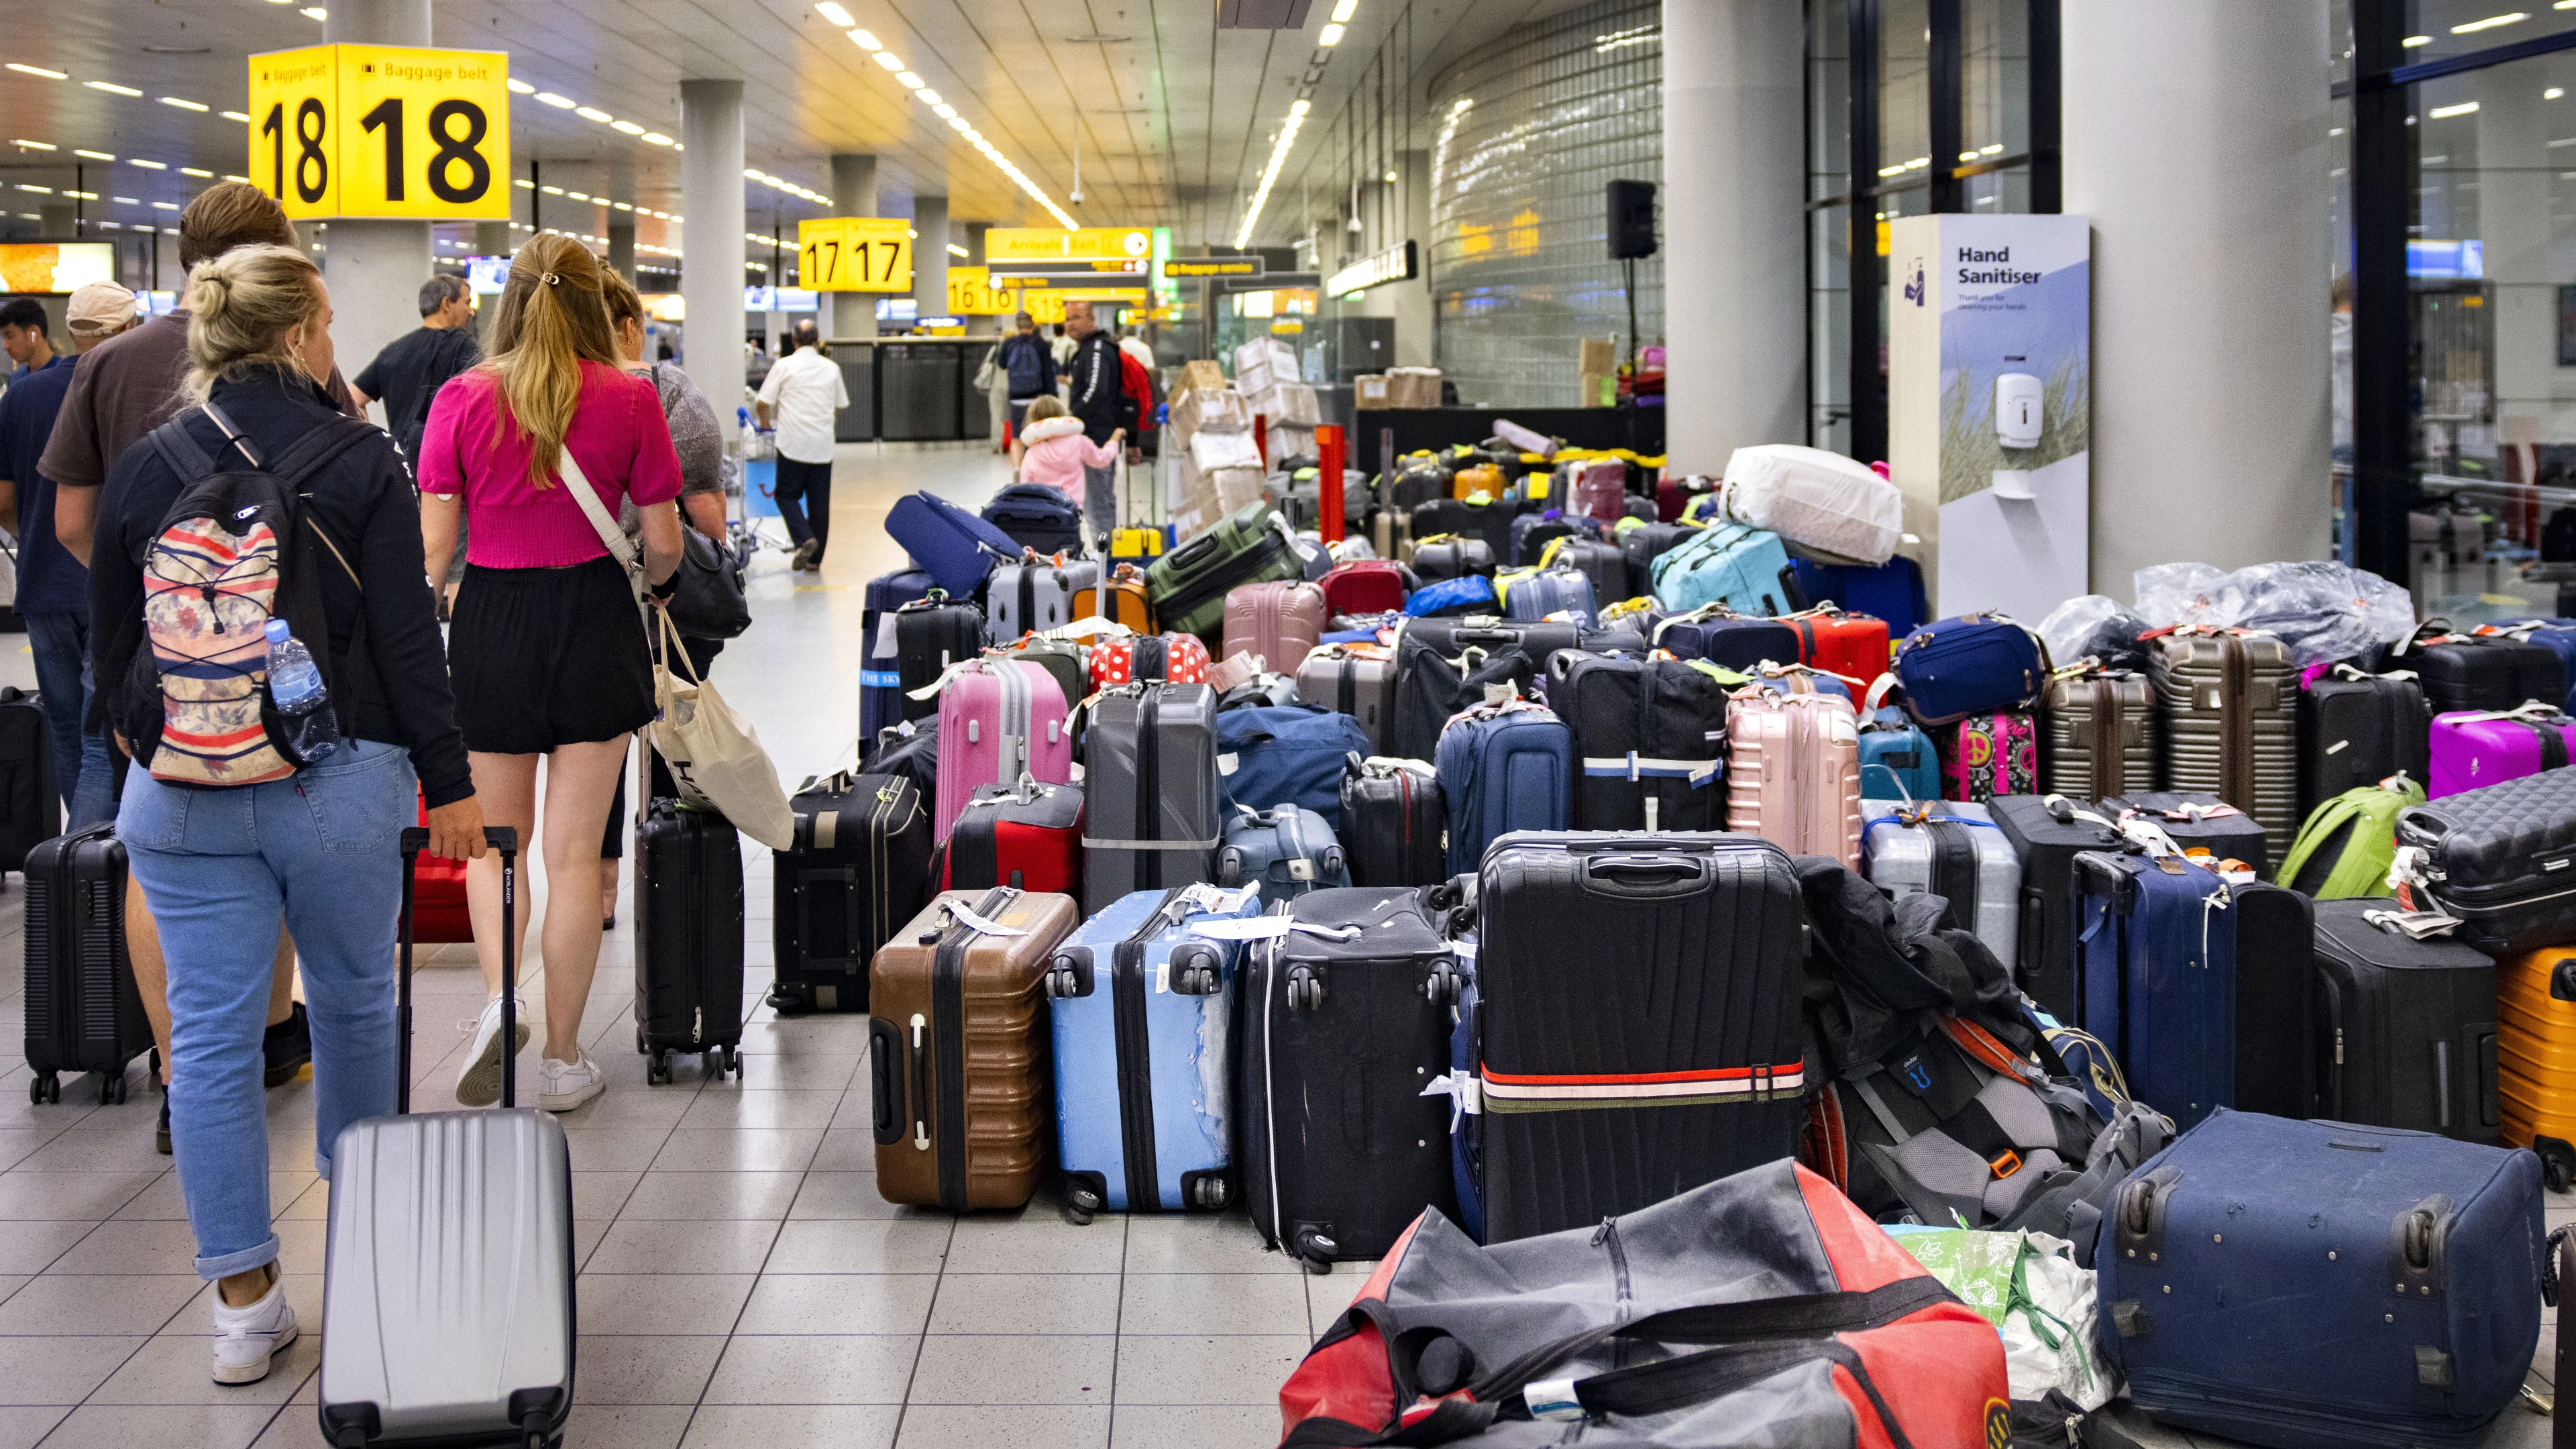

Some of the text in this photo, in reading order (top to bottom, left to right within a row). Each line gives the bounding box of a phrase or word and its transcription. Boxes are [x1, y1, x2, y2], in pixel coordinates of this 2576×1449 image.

[273, 63, 326, 83] Baggage belt
[385, 62, 488, 81] Baggage belt
[263, 98, 327, 203] 18
[360, 98, 490, 203] 18
[808, 242, 839, 282] 17
[855, 242, 900, 282] 17
[1959, 246, 2009, 262] Hand
[1959, 268, 2041, 284] Sanitiser
[949, 282, 973, 308] 16
[1903, 1055, 1919, 1068] deuter
